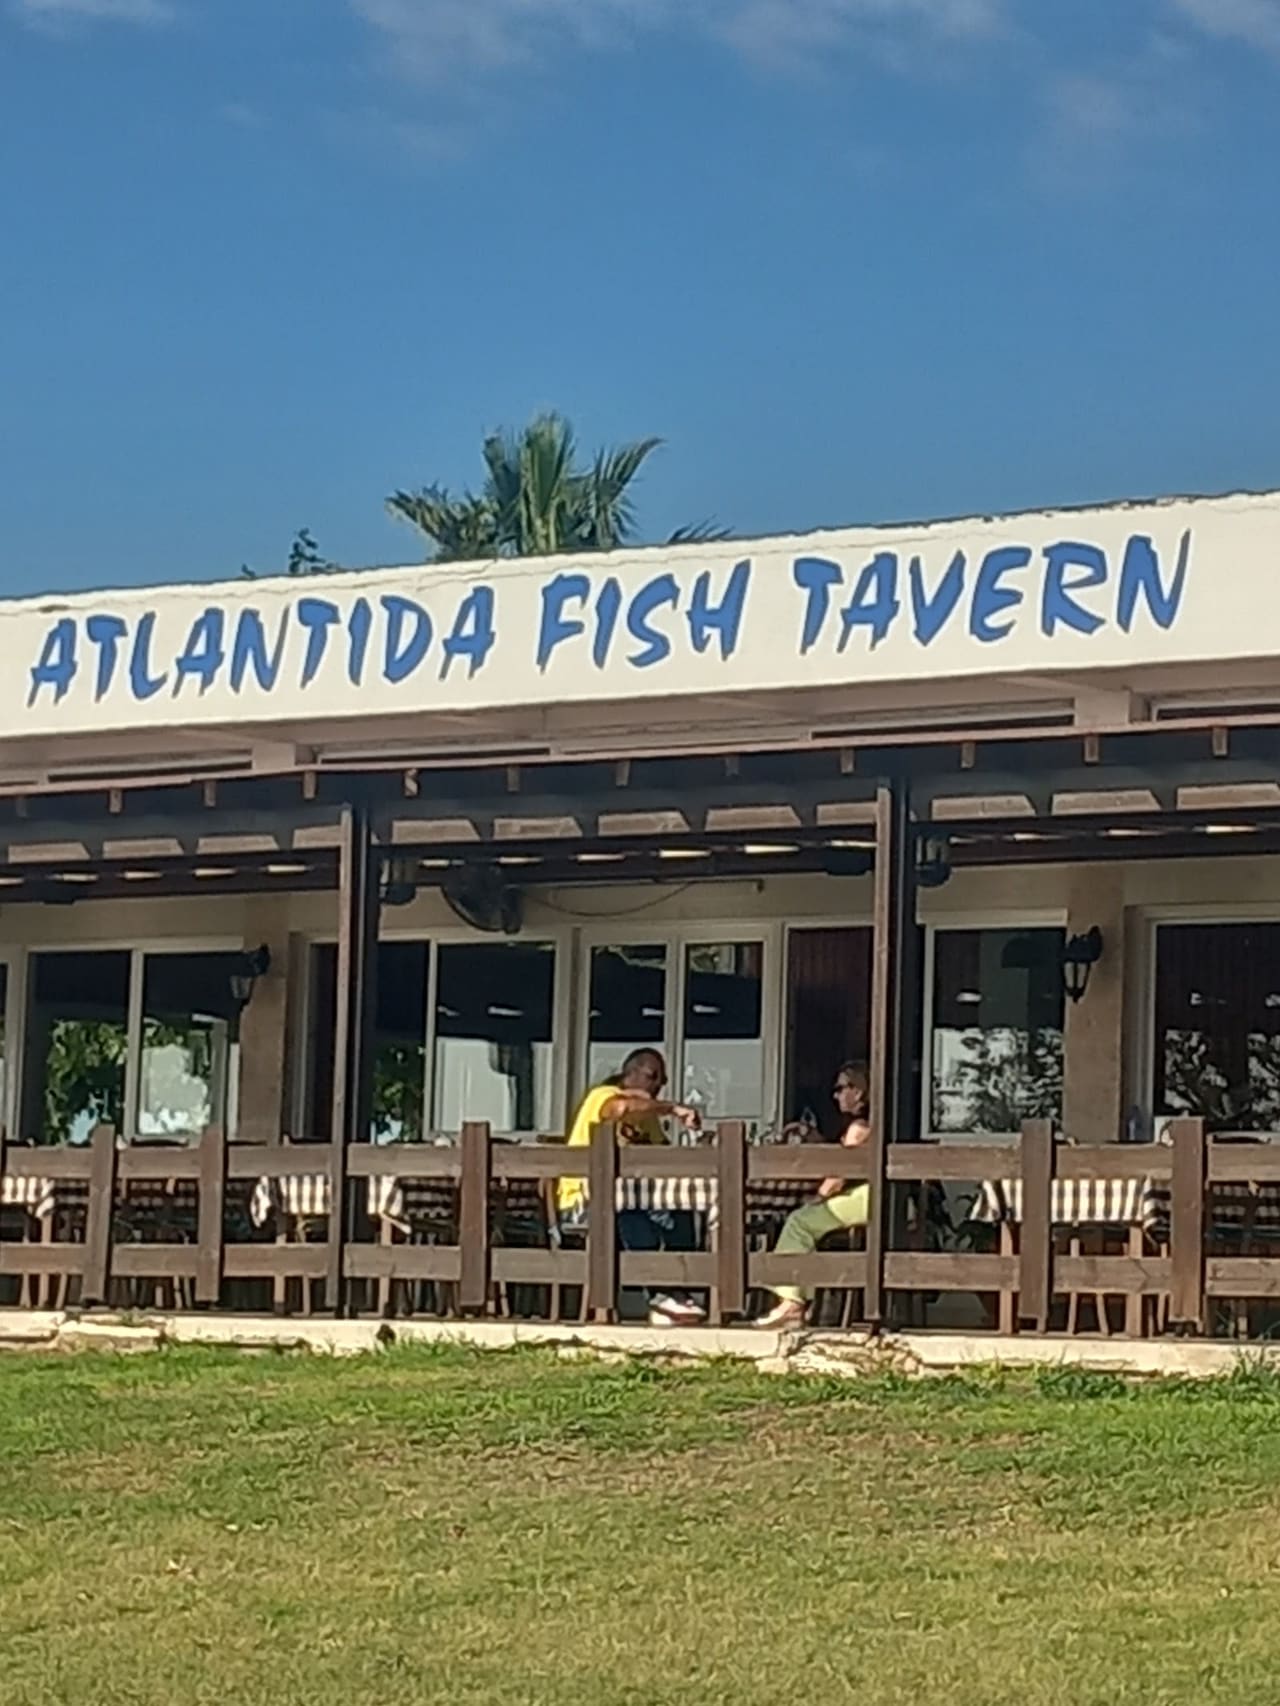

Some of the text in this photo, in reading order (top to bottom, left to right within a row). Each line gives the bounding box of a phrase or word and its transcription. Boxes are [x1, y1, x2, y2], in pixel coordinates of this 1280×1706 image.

[27, 528, 1192, 708] ATLANTIDA FISH TAVERN
